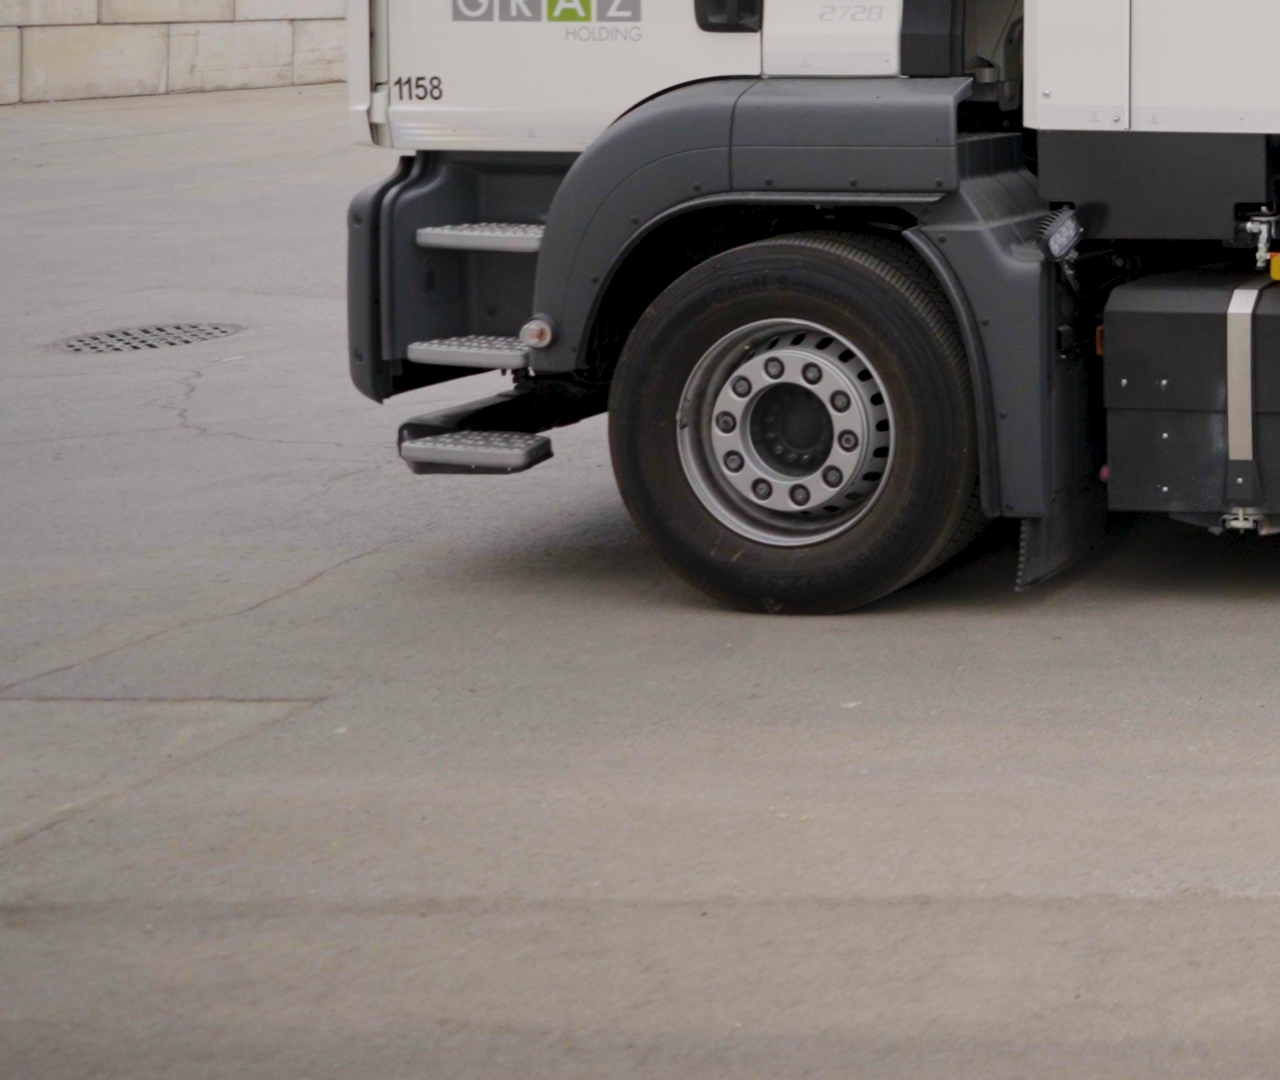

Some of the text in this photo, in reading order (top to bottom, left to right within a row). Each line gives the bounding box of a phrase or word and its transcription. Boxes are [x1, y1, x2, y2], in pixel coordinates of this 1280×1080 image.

[819, 5, 884, 22] 2728
[565, 25, 643, 42] HOLDING
[394, 76, 443, 101] 1158
